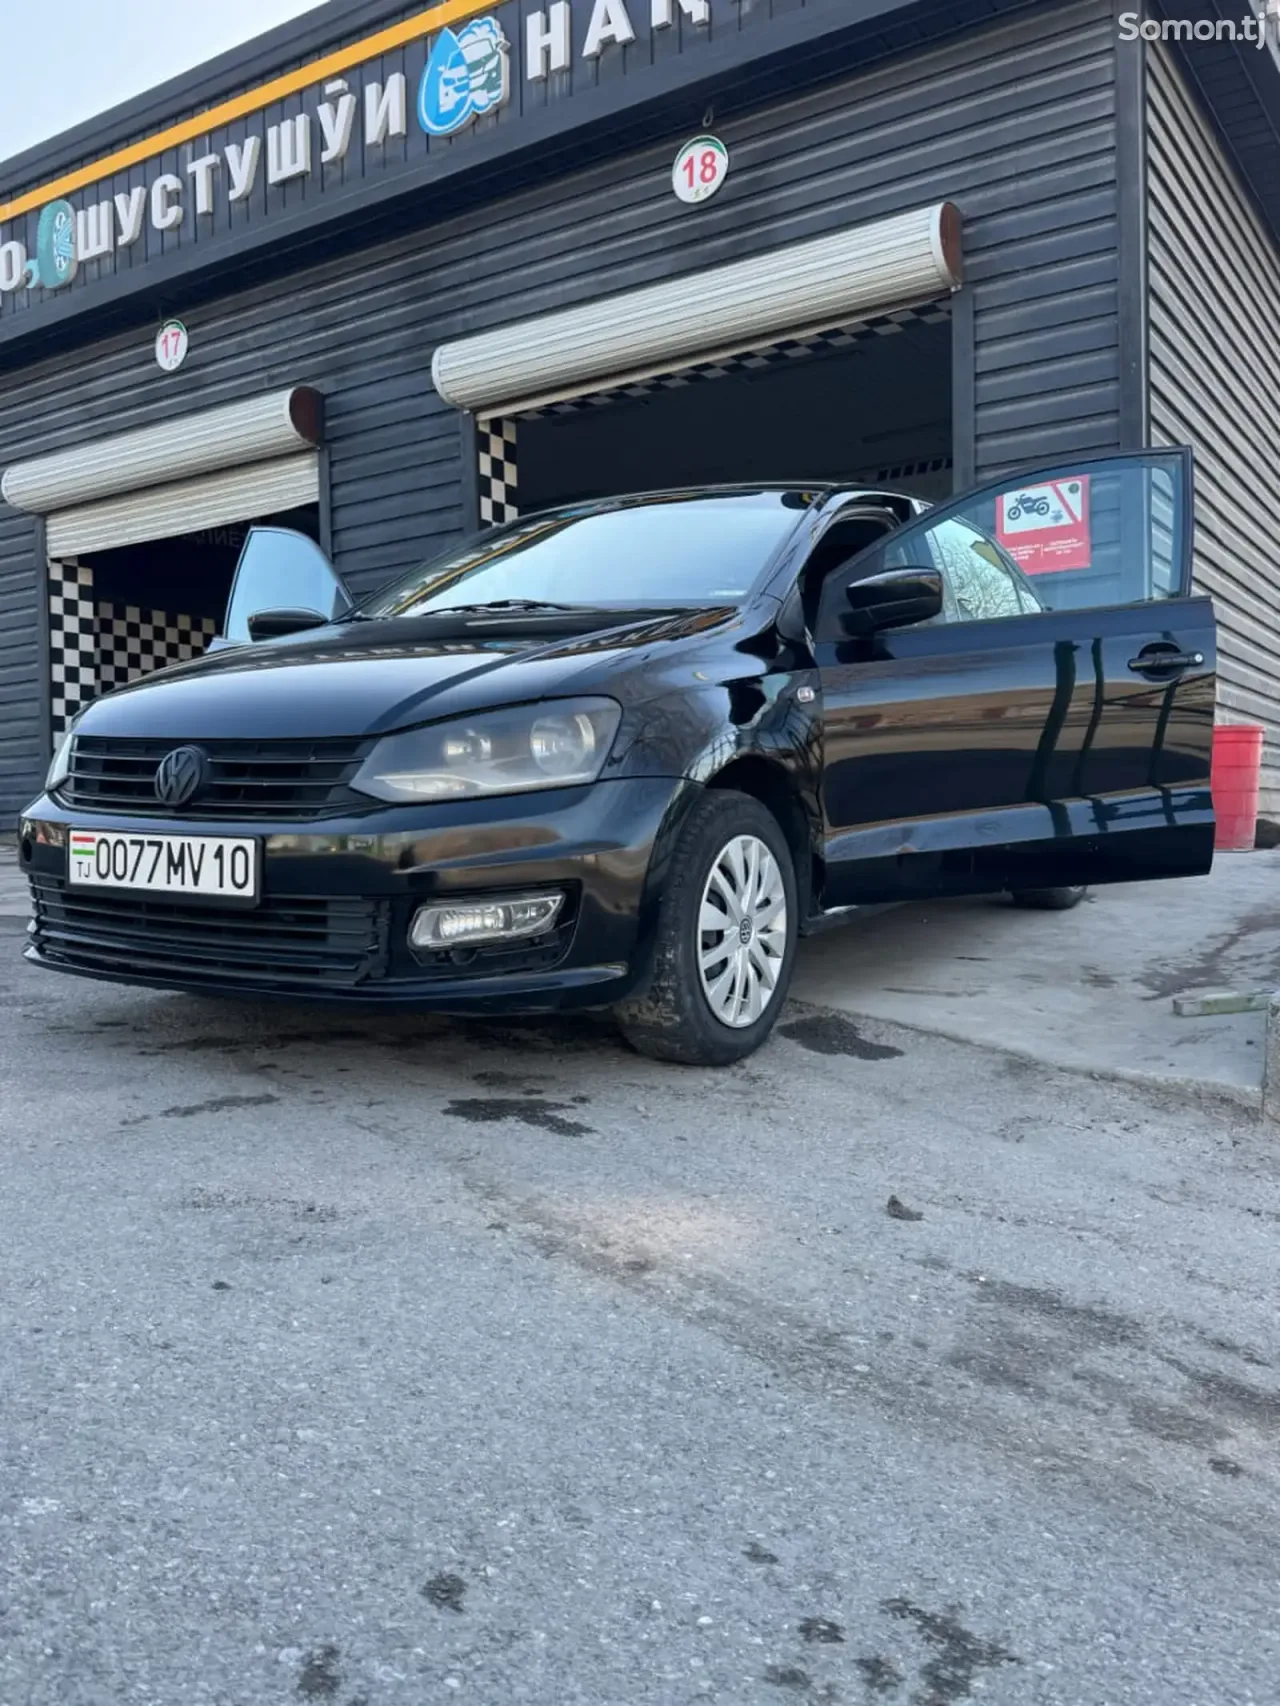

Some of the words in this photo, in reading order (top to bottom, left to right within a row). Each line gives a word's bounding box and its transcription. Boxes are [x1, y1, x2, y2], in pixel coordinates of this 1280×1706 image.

[682, 150, 717, 189] 18
[161, 331, 181, 359] 17
[76, 861, 91, 878] TJ
